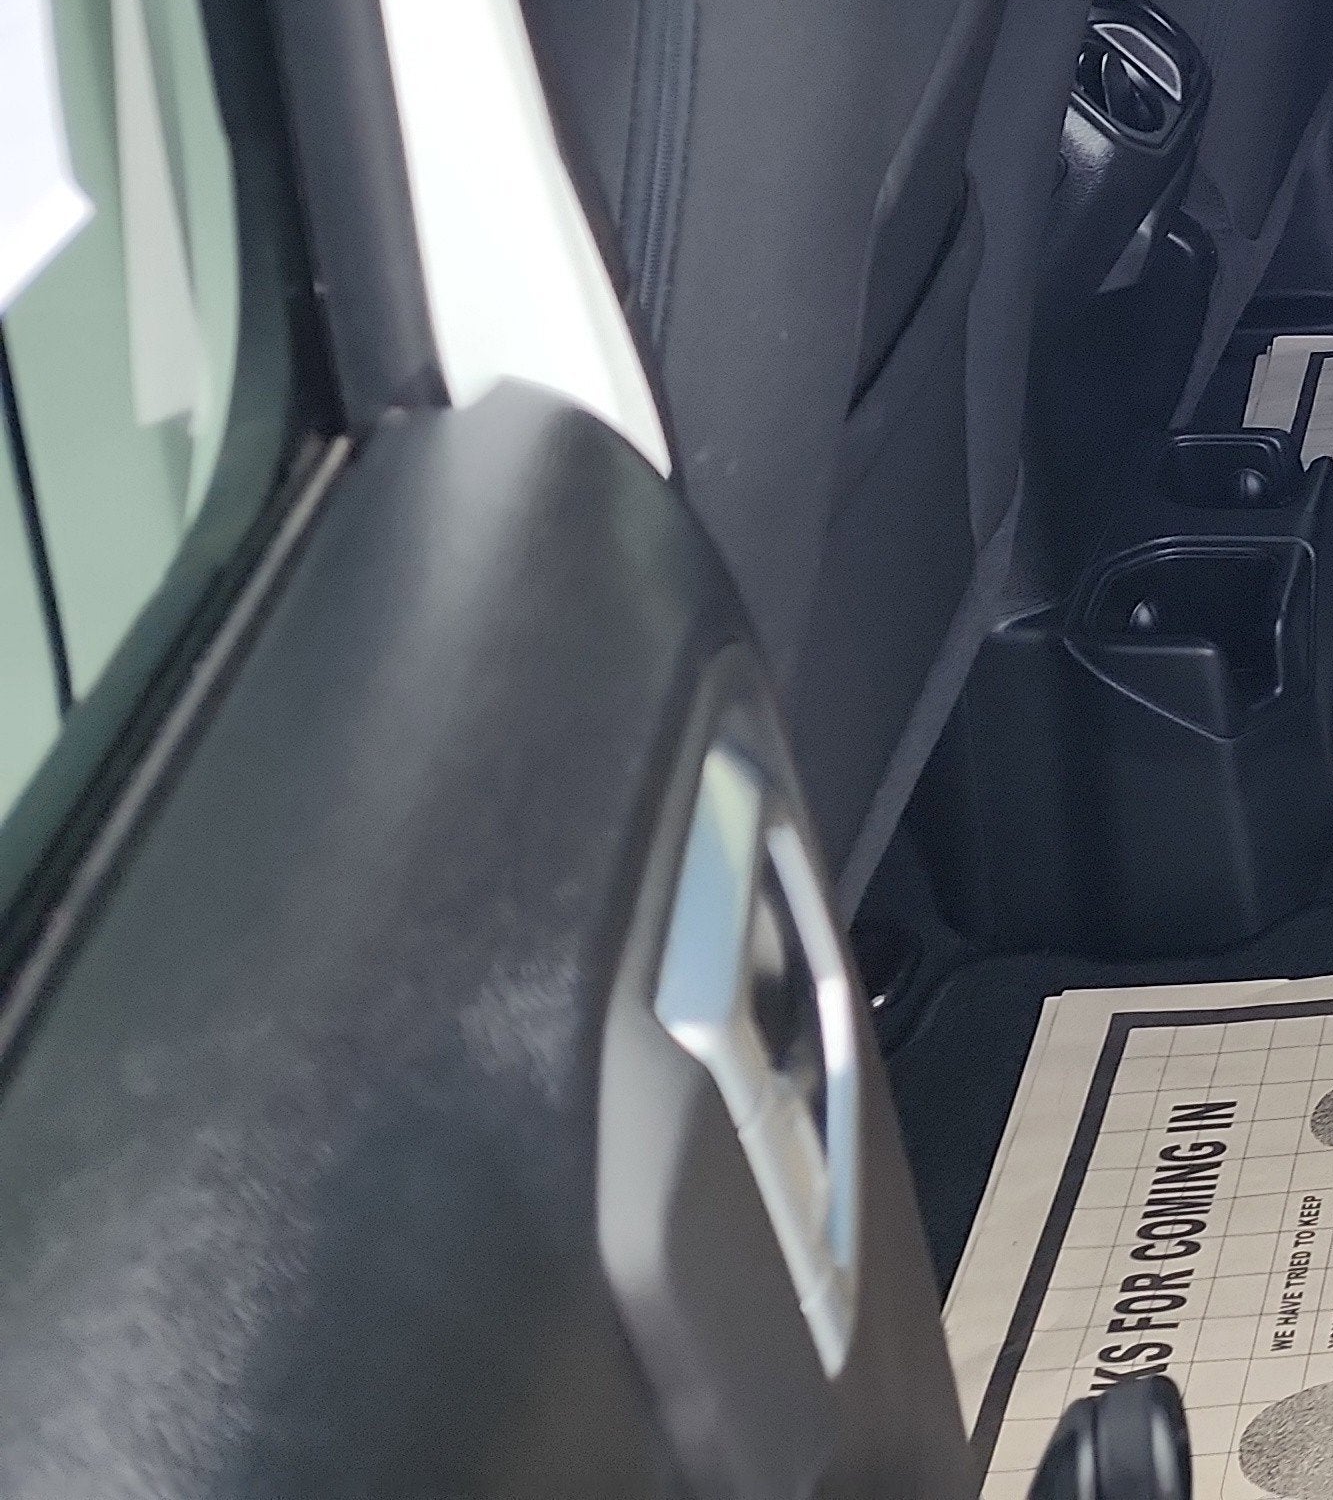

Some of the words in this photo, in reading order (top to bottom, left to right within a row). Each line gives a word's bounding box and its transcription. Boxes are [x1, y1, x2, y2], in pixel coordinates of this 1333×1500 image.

[1166, 1101, 1238, 1134] IN
[1130, 1140, 1227, 1262] COMING
[1297, 1195, 1322, 1227] KEEP
[1293, 1230, 1316, 1248] TO
[1284, 1251, 1311, 1289] TRIED
[1106, 1268, 1195, 1334] FOR
[1276, 1291, 1303, 1326] HAVE
[1270, 1329, 1295, 1352] WE
